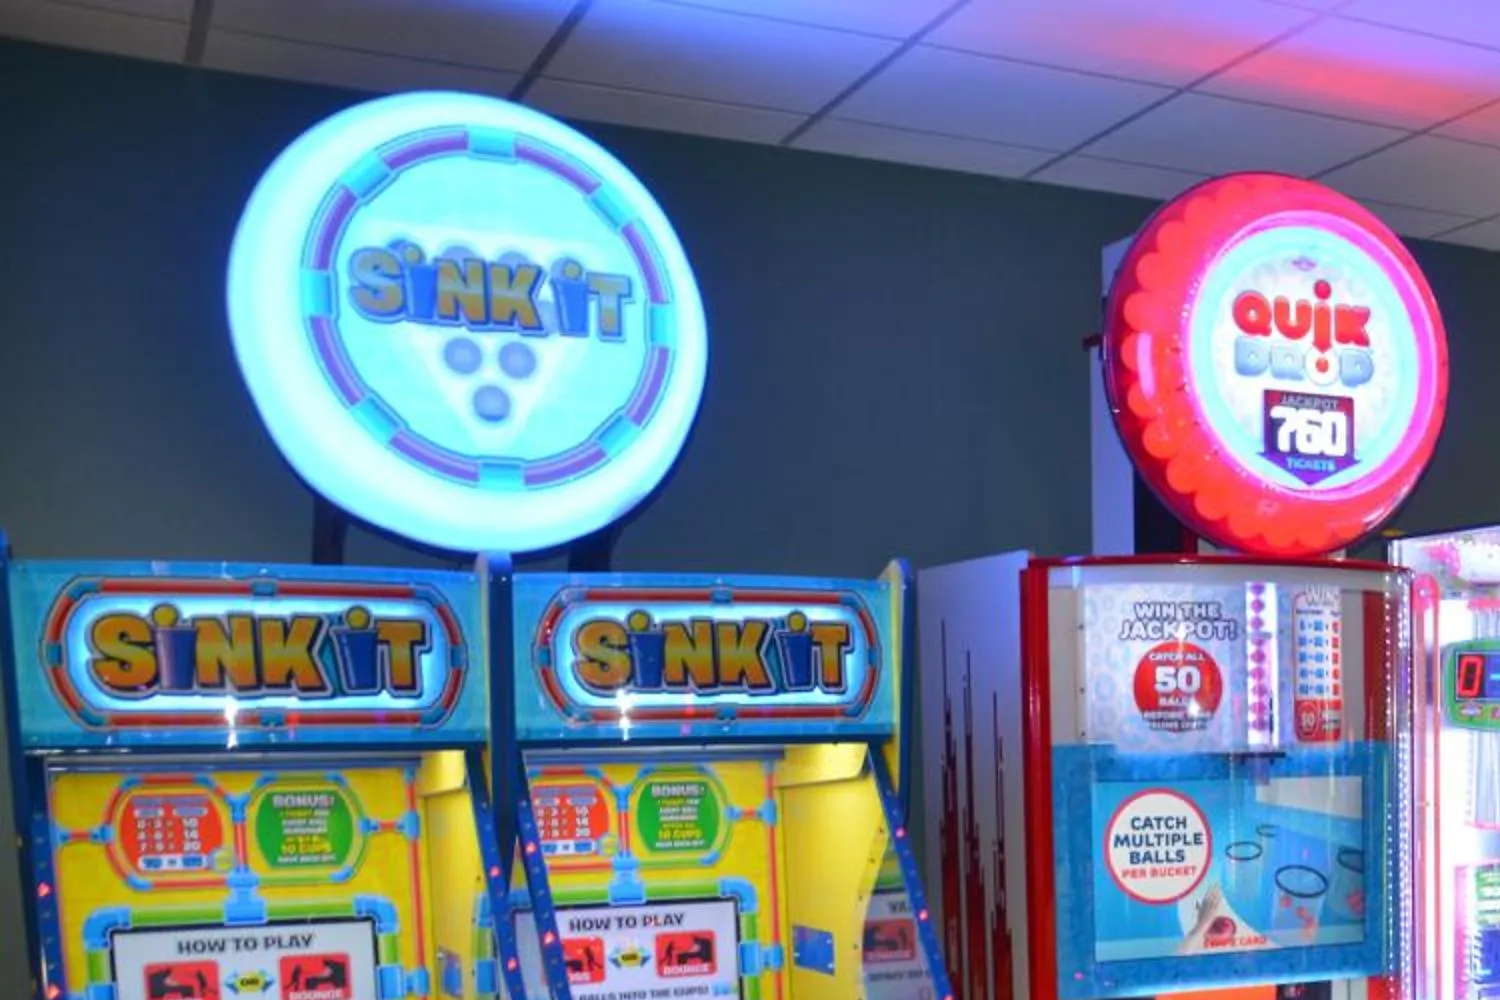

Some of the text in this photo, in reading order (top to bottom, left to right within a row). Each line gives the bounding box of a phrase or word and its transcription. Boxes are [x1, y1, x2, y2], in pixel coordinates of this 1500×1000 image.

[1270, 405, 1347, 456] 760
[1134, 602, 1222, 622] WIN THE
[1119, 619, 1239, 641] JACKPOT!
[1154, 666, 1200, 693] 50
[1131, 815, 1188, 830] CATCH
[1114, 831, 1204, 848] MULTIPLE
[1129, 849, 1186, 865] BALLS
[1122, 866, 1197, 879] PER BUCKET
[568, 912, 687, 933] HOW TO PLAY
[177, 933, 314, 955] HOW TO PLAY
